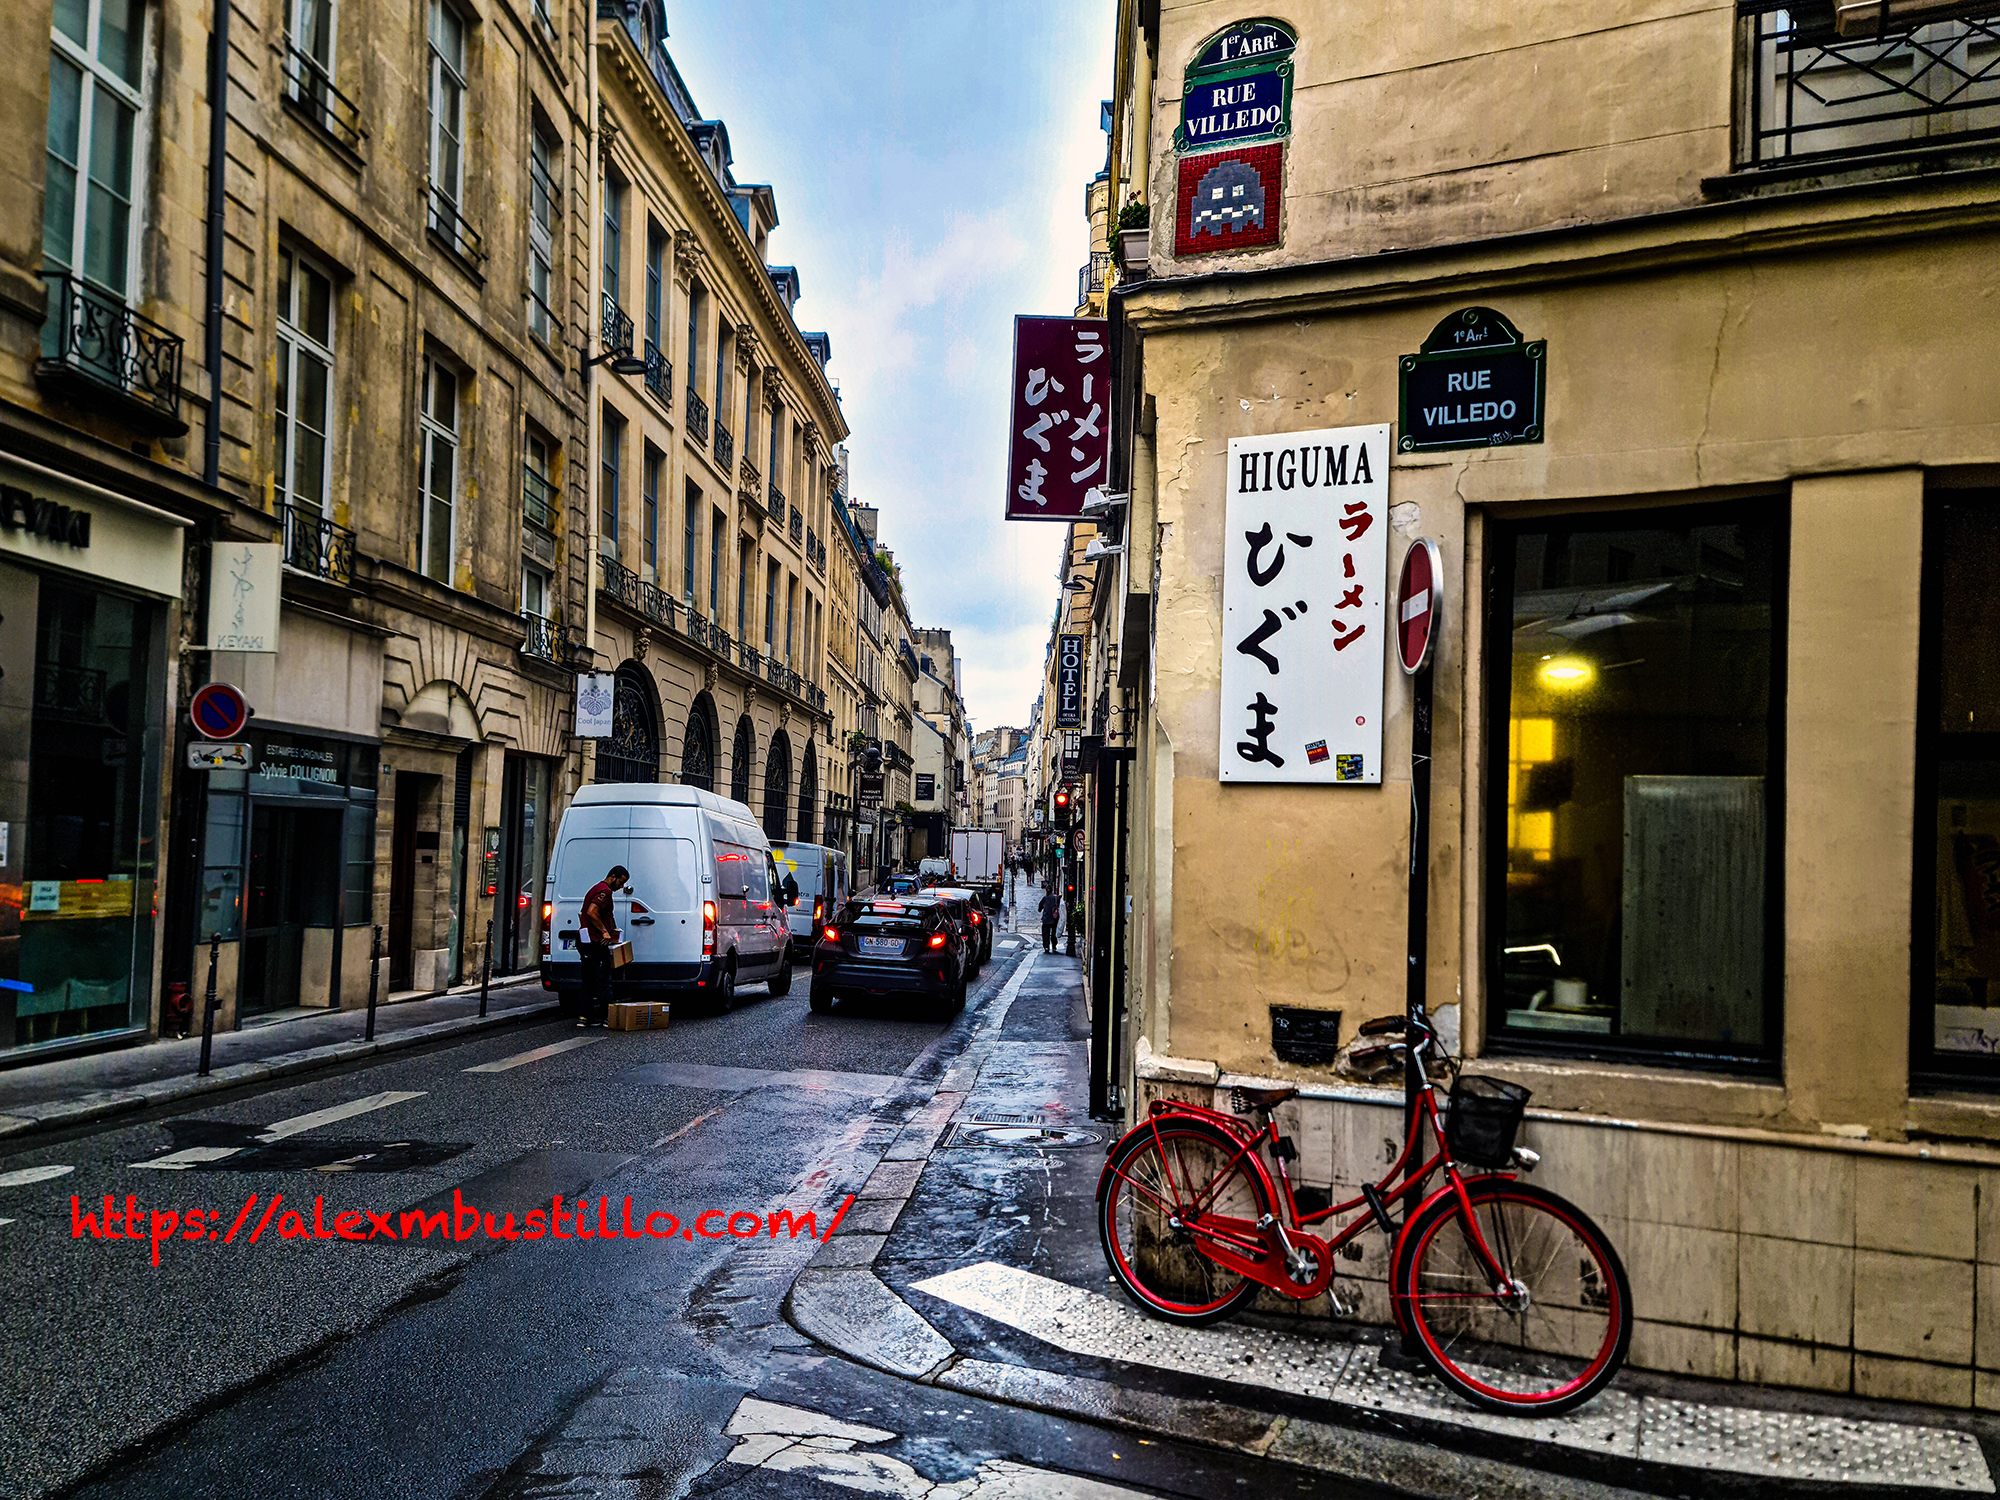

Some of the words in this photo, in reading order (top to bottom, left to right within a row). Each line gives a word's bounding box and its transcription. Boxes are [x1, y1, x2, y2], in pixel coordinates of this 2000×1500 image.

[1212, 82, 1256, 107] RUE
[1187, 104, 1281, 137] VILLEDO
[1447, 369, 1491, 392] RUE
[1068, 331, 1104, 483] ラーメン
[1423, 400, 1517, 426] VILLEDO
[1018, 367, 1070, 506] ひぐま
[1238, 442, 1374, 494] HIGUMA
[1331, 501, 1374, 652] ラーメン
[217, 635, 263, 649] KEYAKI
[1236, 522, 1314, 769] ひぐま
[1062, 639, 1080, 711] HOTEL
[578, 717, 592, 725] Cool
[594, 717, 611, 726] Japan
[266, 744, 299, 758] ESTAMPES
[300, 748, 334, 763] ORIGINALES
[260, 761, 288, 780] Sylvie
[289, 764, 337, 783] COLLIGNON
